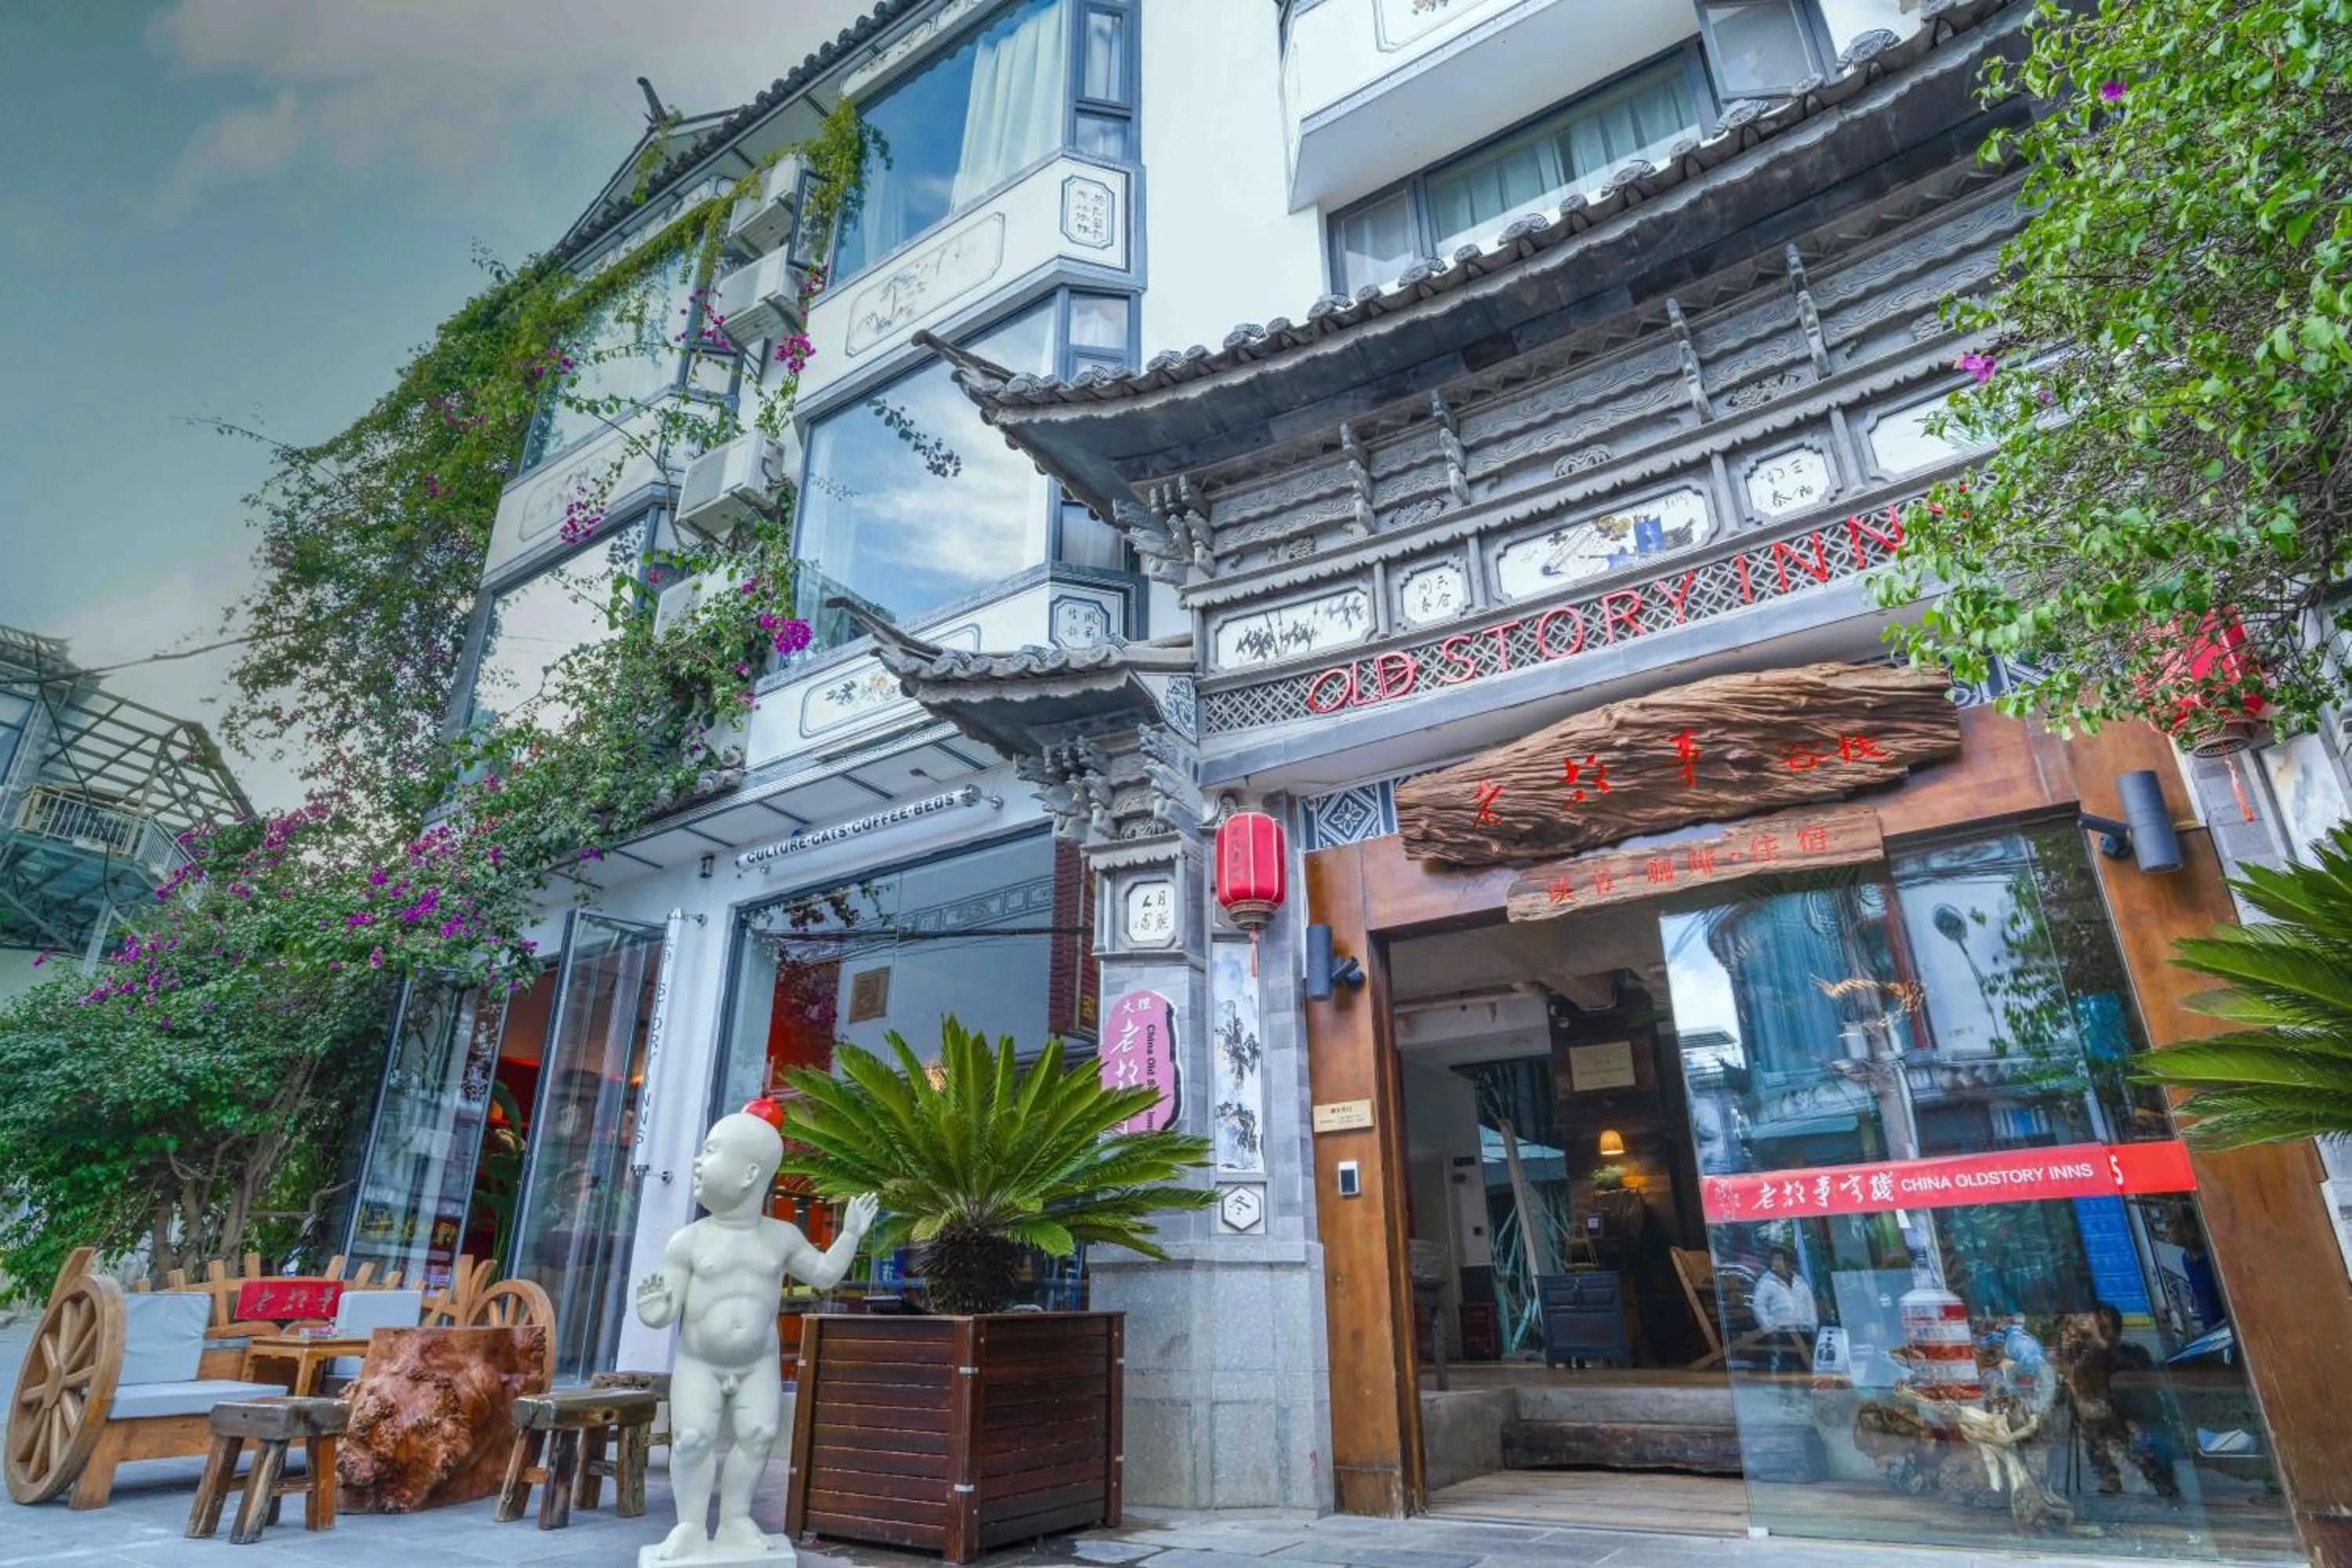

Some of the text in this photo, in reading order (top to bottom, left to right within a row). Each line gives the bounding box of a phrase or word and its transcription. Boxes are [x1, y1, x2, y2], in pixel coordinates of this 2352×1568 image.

[1440, 569, 1697, 684] STORY
[1737, 483, 1969, 603] INN
[1147, 1024, 1156, 1054] China
[1147, 1058, 1156, 1076] Old
[1900, 1163, 2094, 1192] CHINA OLDSTORY INNS
